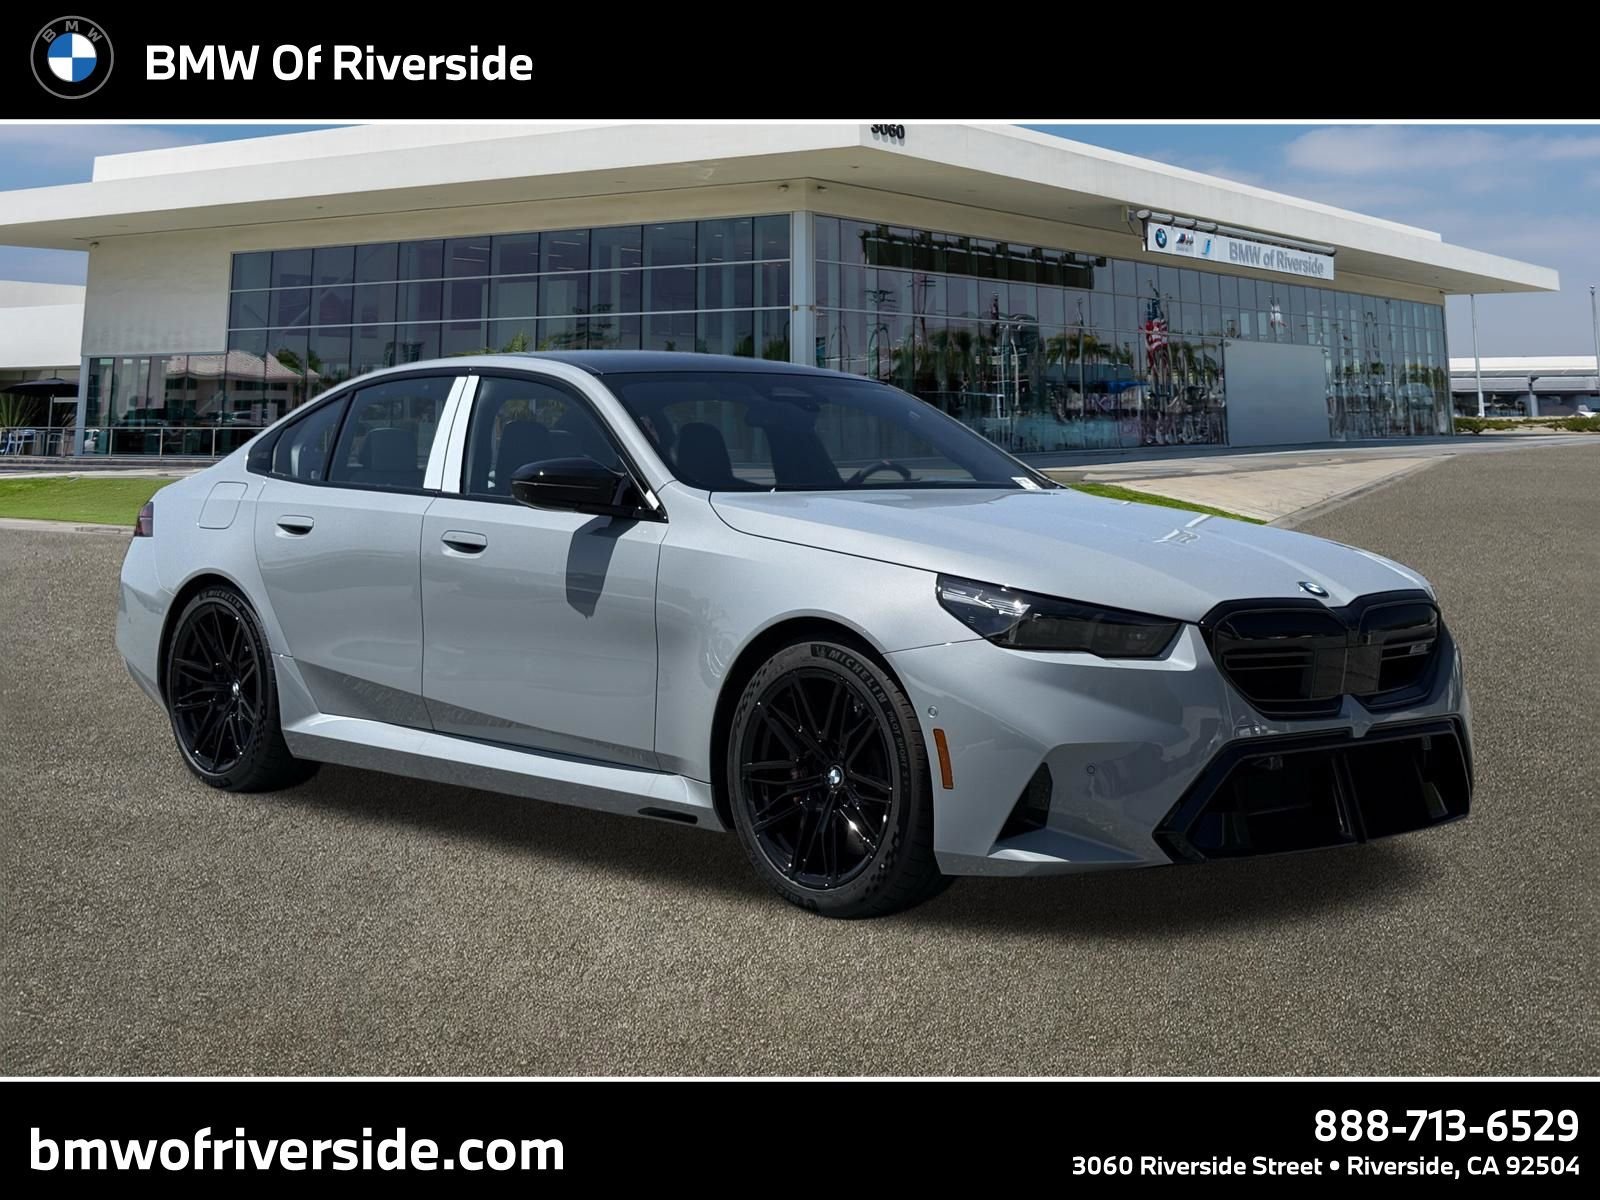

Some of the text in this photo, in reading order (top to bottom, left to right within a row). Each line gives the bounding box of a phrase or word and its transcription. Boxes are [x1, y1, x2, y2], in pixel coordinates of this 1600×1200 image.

[1229, 241, 1261, 265] BMW
[1263, 249, 1275, 266] of
[1276, 250, 1324, 275] Riverside
[828, 650, 888, 704] MICHELIN
